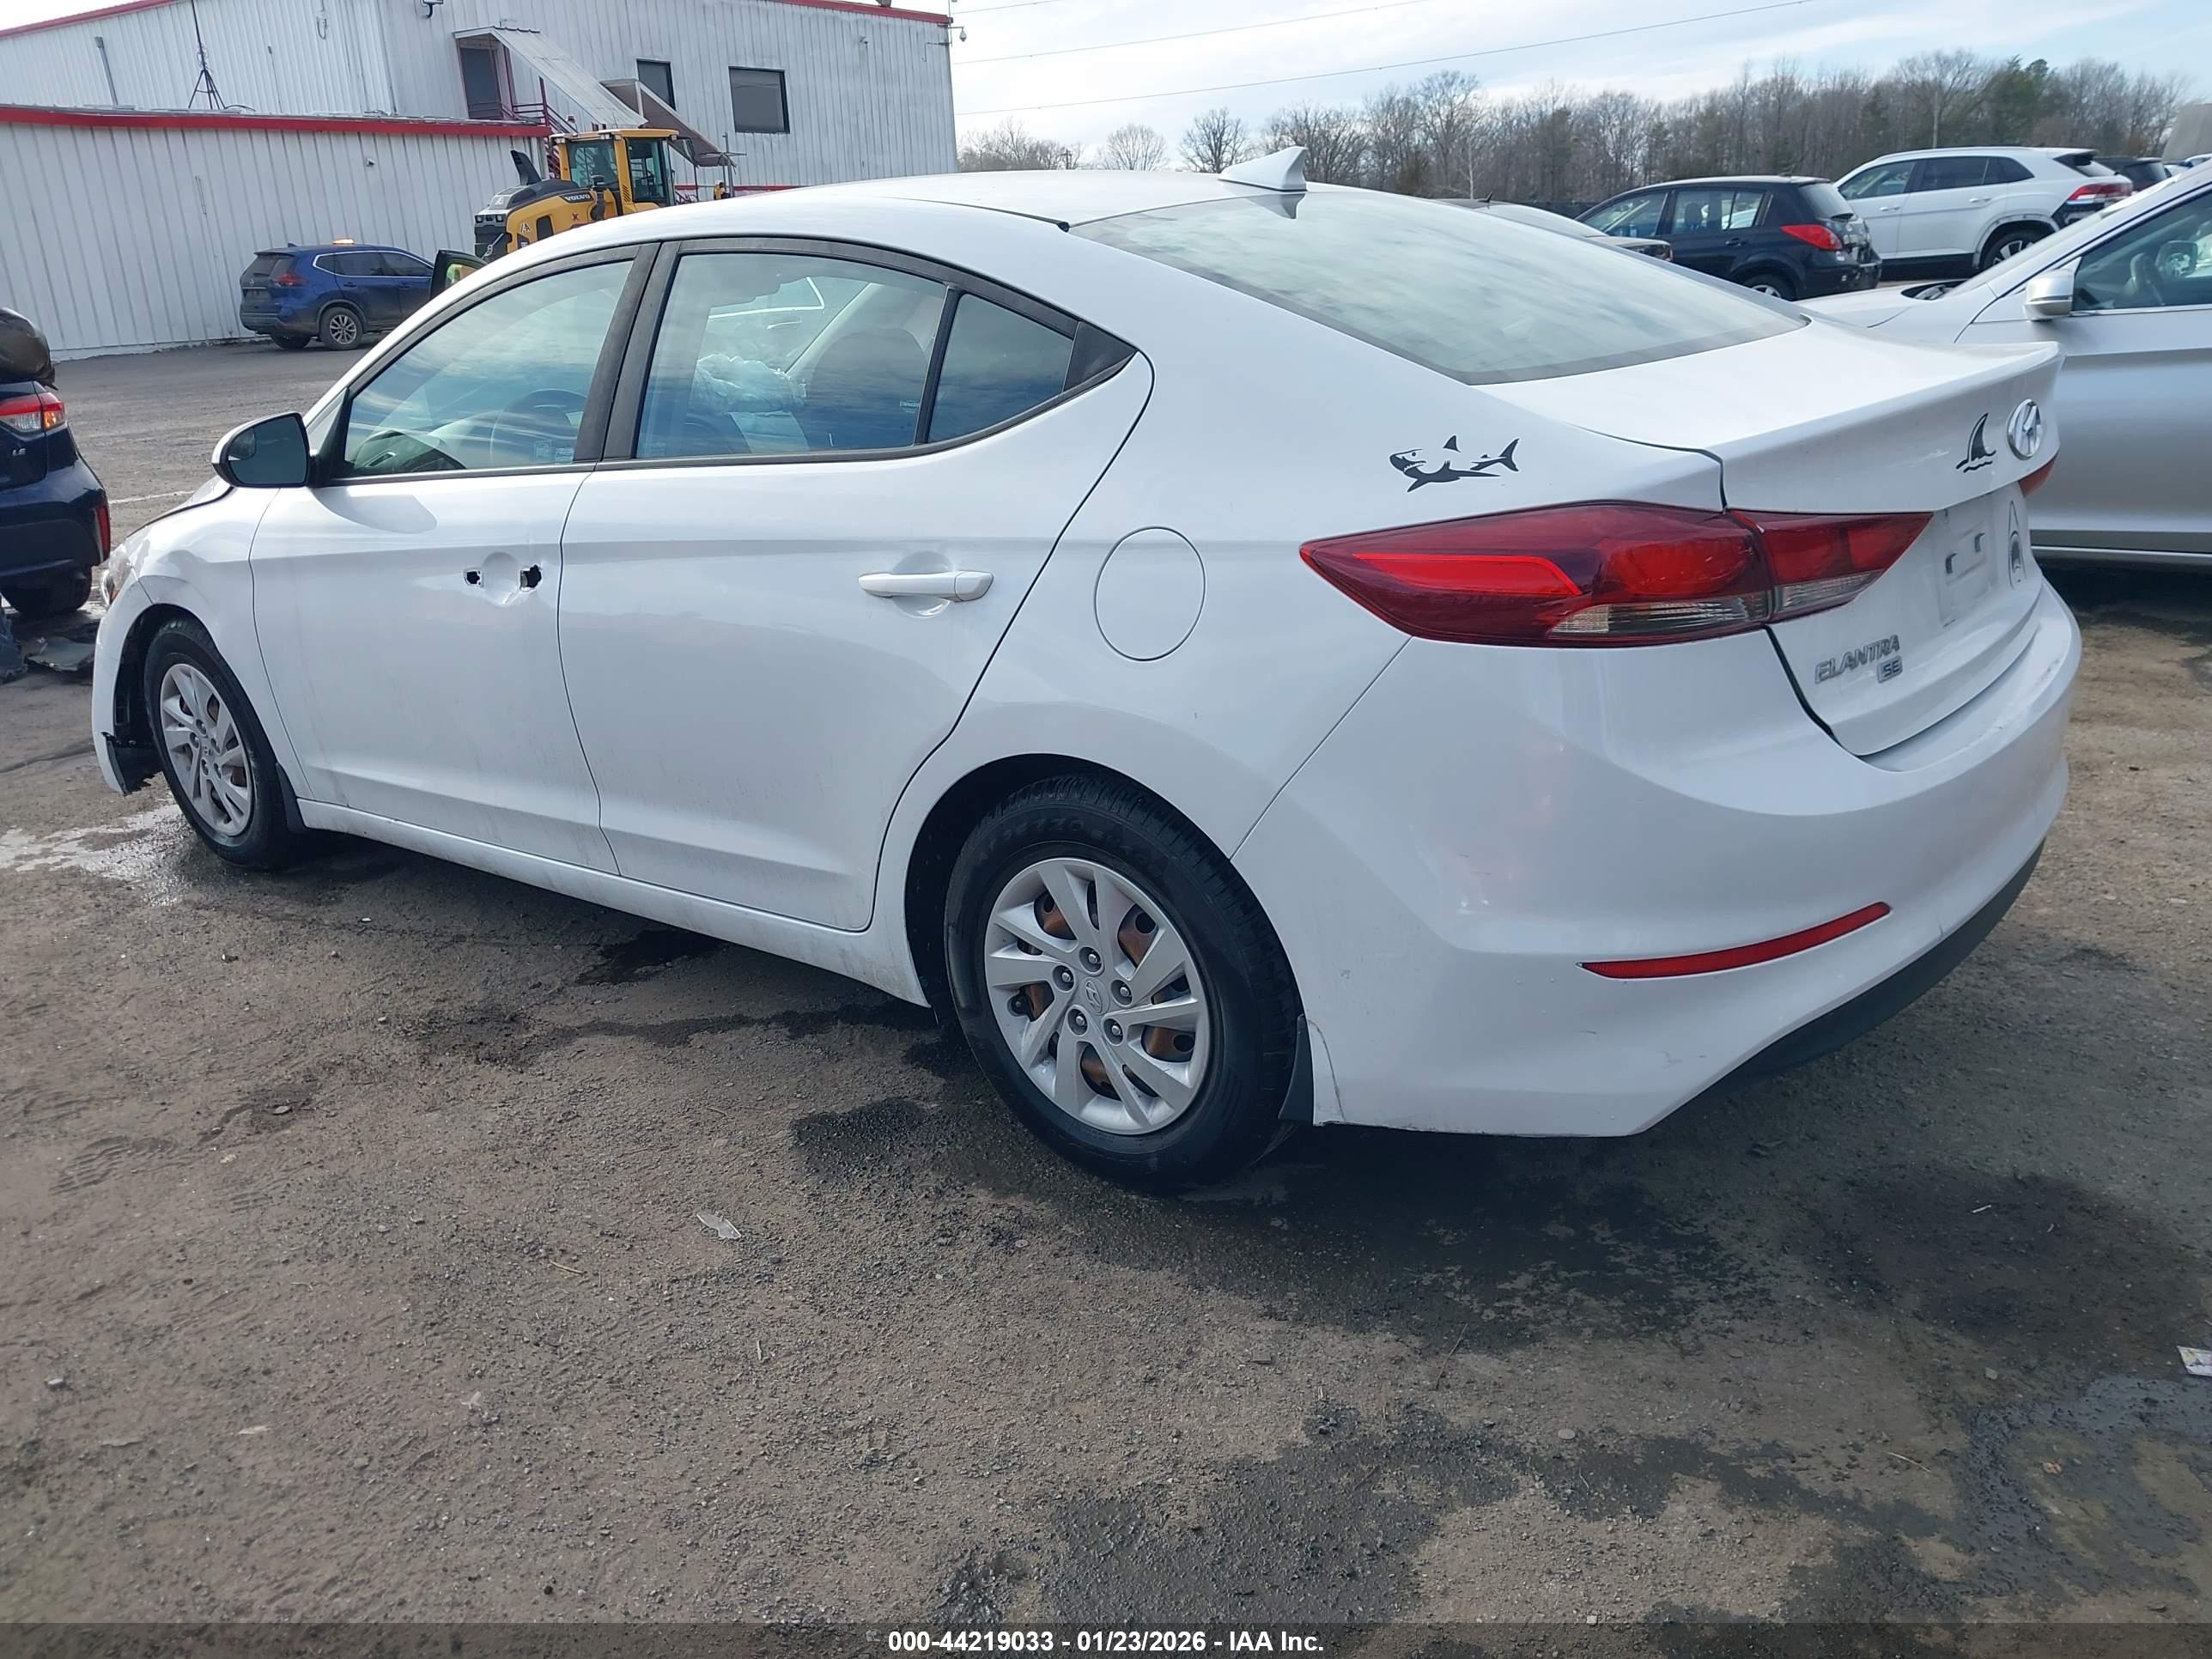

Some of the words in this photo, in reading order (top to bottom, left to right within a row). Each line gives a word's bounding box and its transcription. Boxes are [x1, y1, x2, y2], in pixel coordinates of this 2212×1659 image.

[12, 447, 26, 456] LE
[1814, 634, 1900, 684] ELANTRA
[1881, 659, 1901, 678] SE
